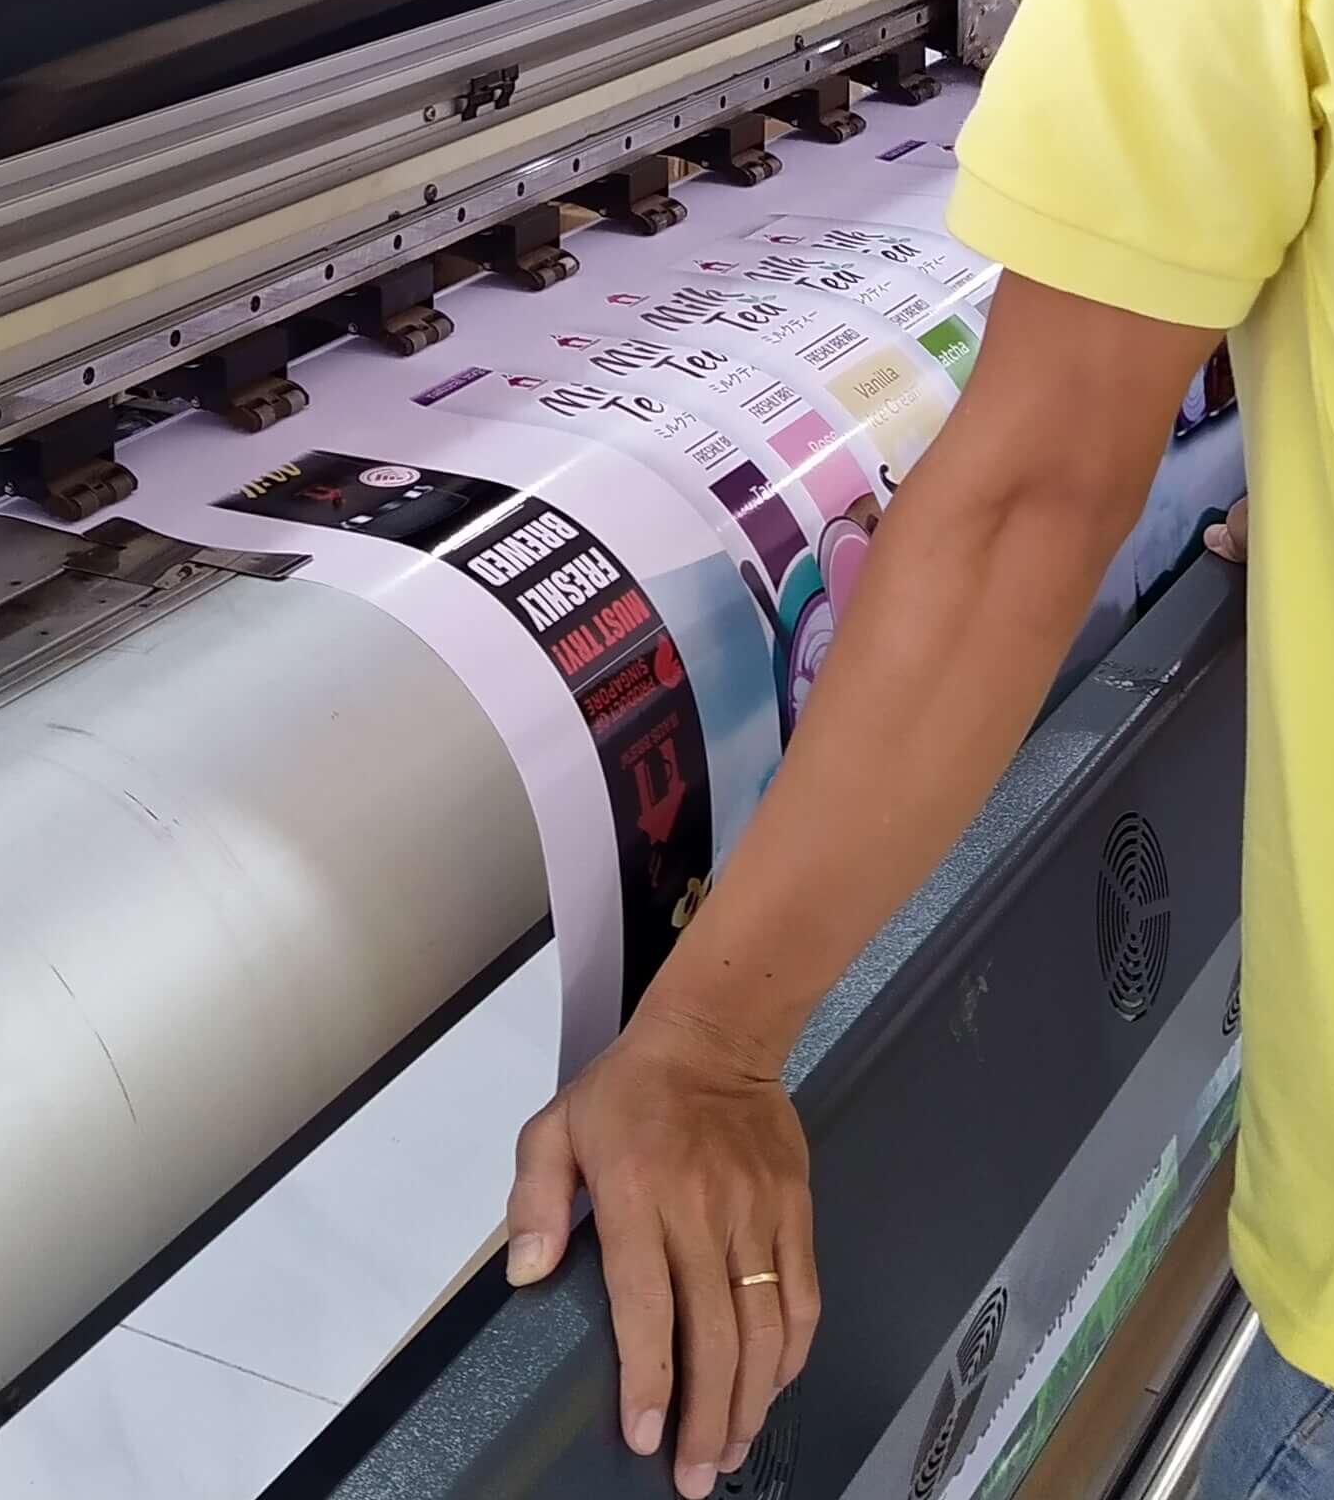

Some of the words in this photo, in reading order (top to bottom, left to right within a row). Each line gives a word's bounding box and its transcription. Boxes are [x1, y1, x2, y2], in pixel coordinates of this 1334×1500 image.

[794, 269, 866, 292] Tea
[640, 287, 745, 332] Milk
[702, 300, 788, 332] Tea
[853, 365, 901, 400] Vanilla
[466, 510, 580, 588] BREWED
[516, 545, 622, 633] FRESHLY
[591, 587, 652, 647] MUST
[551, 623, 605, 677] TRY!
[583, 658, 650, 717] SINGAPORE
[608, 674, 658, 727] PRODUCT
